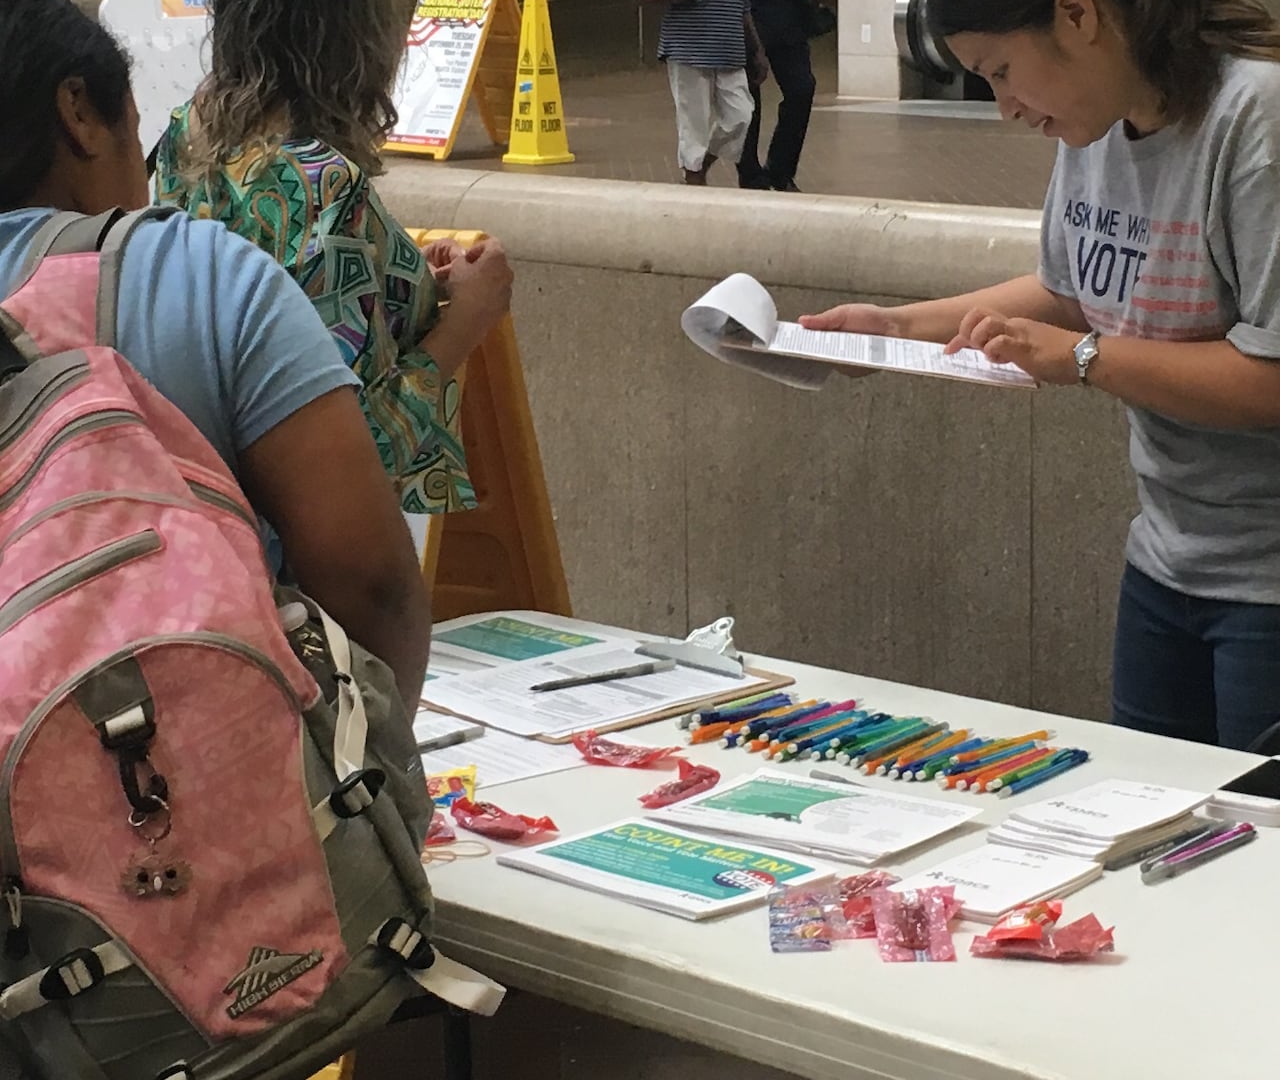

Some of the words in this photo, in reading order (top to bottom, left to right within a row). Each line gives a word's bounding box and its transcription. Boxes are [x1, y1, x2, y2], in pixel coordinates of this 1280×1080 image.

[542, 101, 557, 114] WET
[515, 119, 533, 133] FLOOR
[541, 118, 562, 132] FLOOR
[1064, 199, 1093, 231] ASK
[1095, 207, 1121, 237] ME
[614, 823, 709, 852] COUNT
[706, 846, 755, 864] ME
[230, 987, 269, 1016] HIGH
[268, 950, 321, 992] SIERRA
